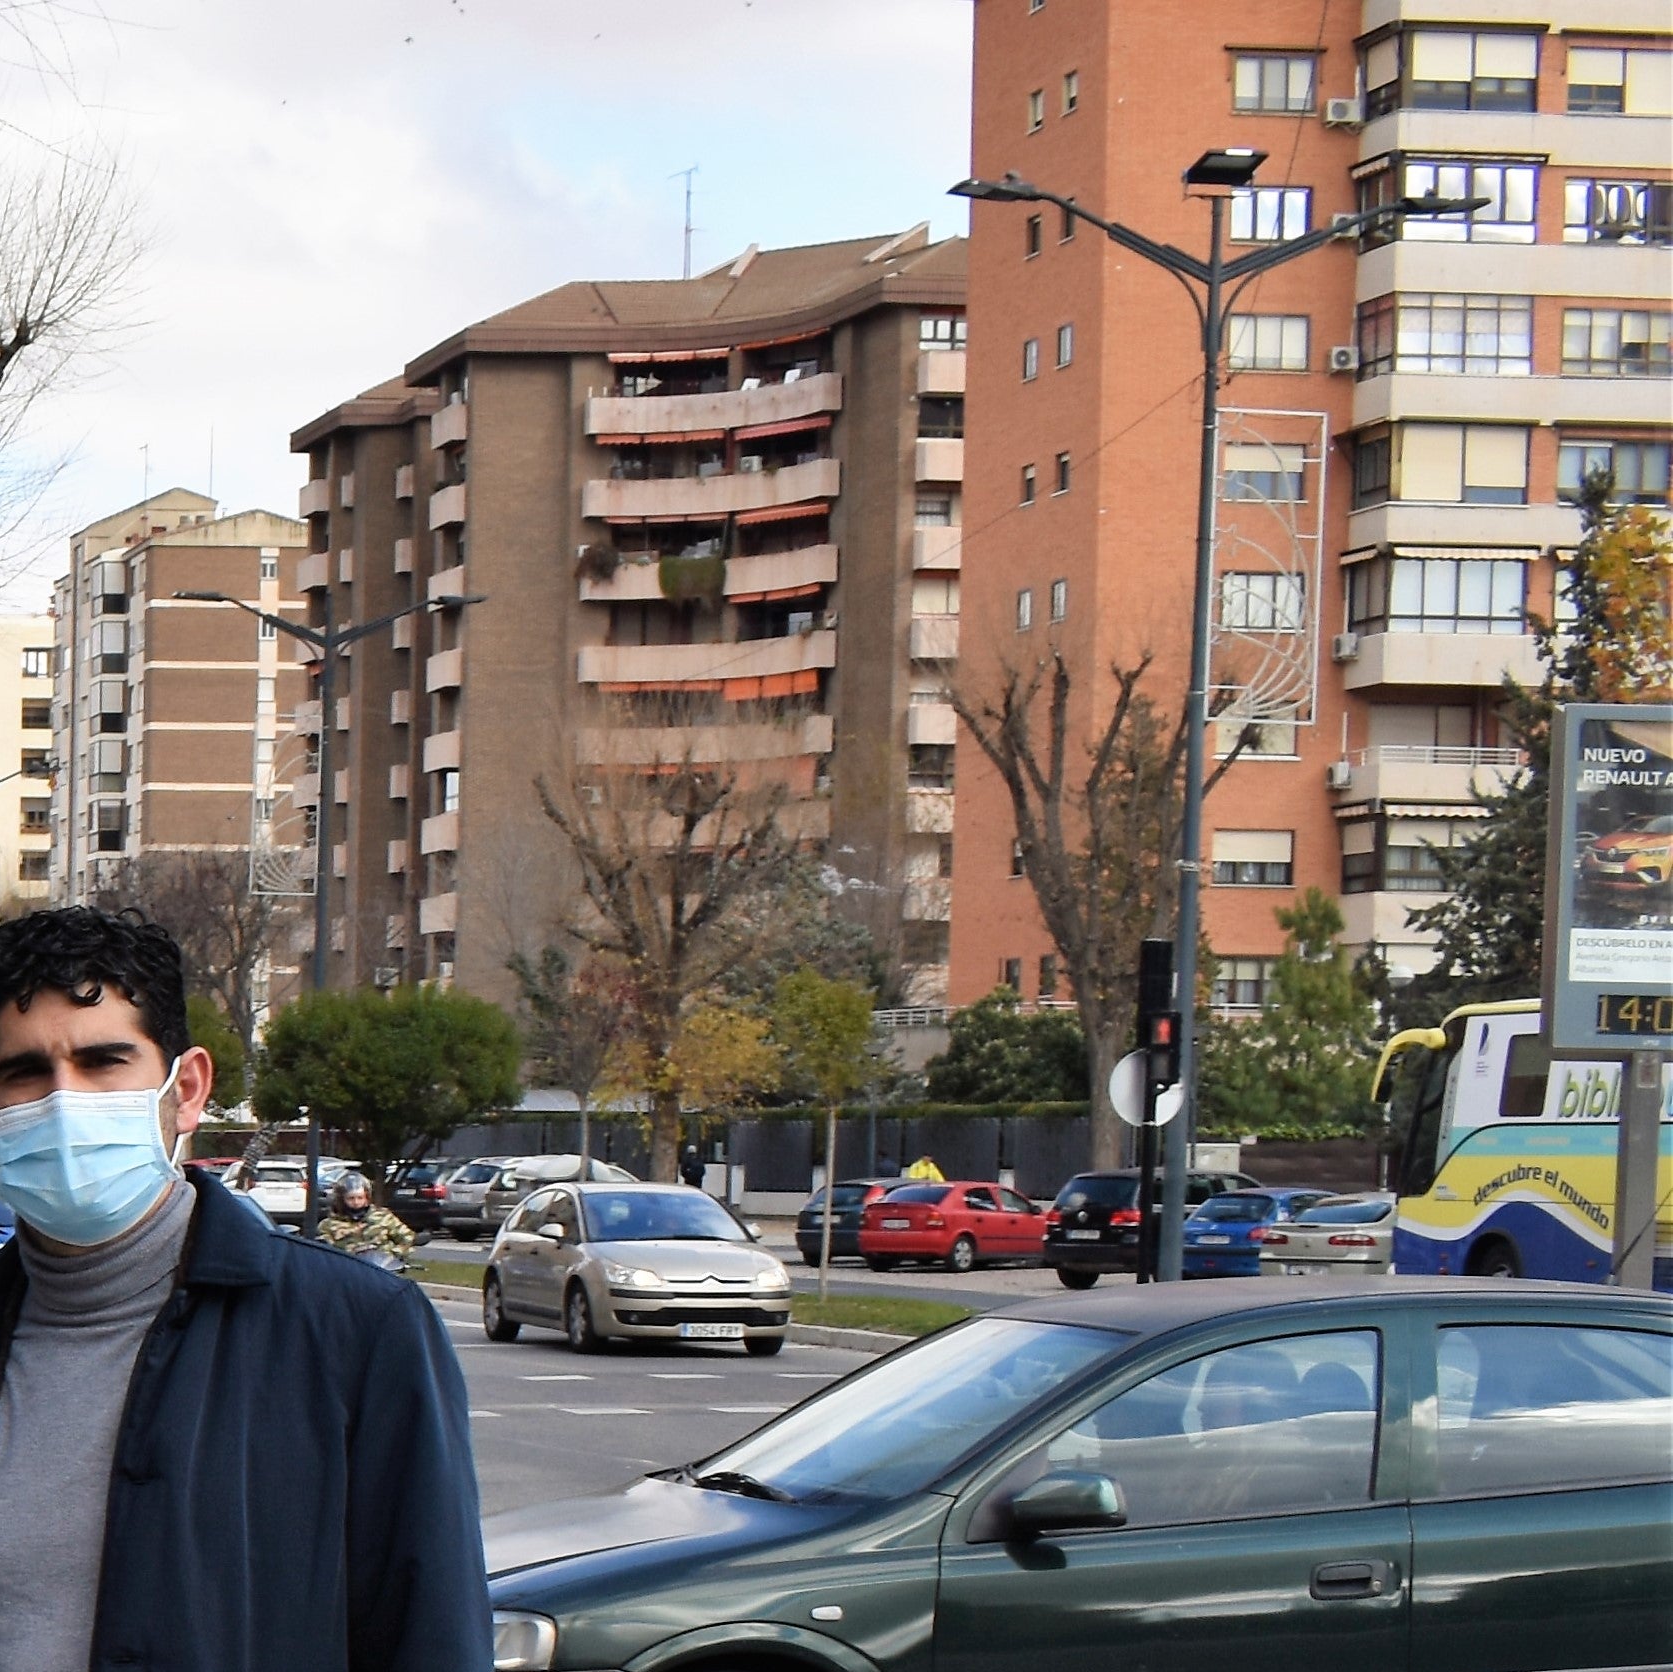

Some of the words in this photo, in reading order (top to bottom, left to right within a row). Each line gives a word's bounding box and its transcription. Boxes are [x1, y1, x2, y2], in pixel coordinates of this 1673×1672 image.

[1583, 747, 1646, 763] NUEVO
[1583, 769, 1663, 786] RENAULT
[1649, 940, 1663, 949] EN
[1474, 1164, 1541, 1206] descubre
[1545, 1170, 1559, 1188] el
[1559, 1180, 1609, 1230] mundo
